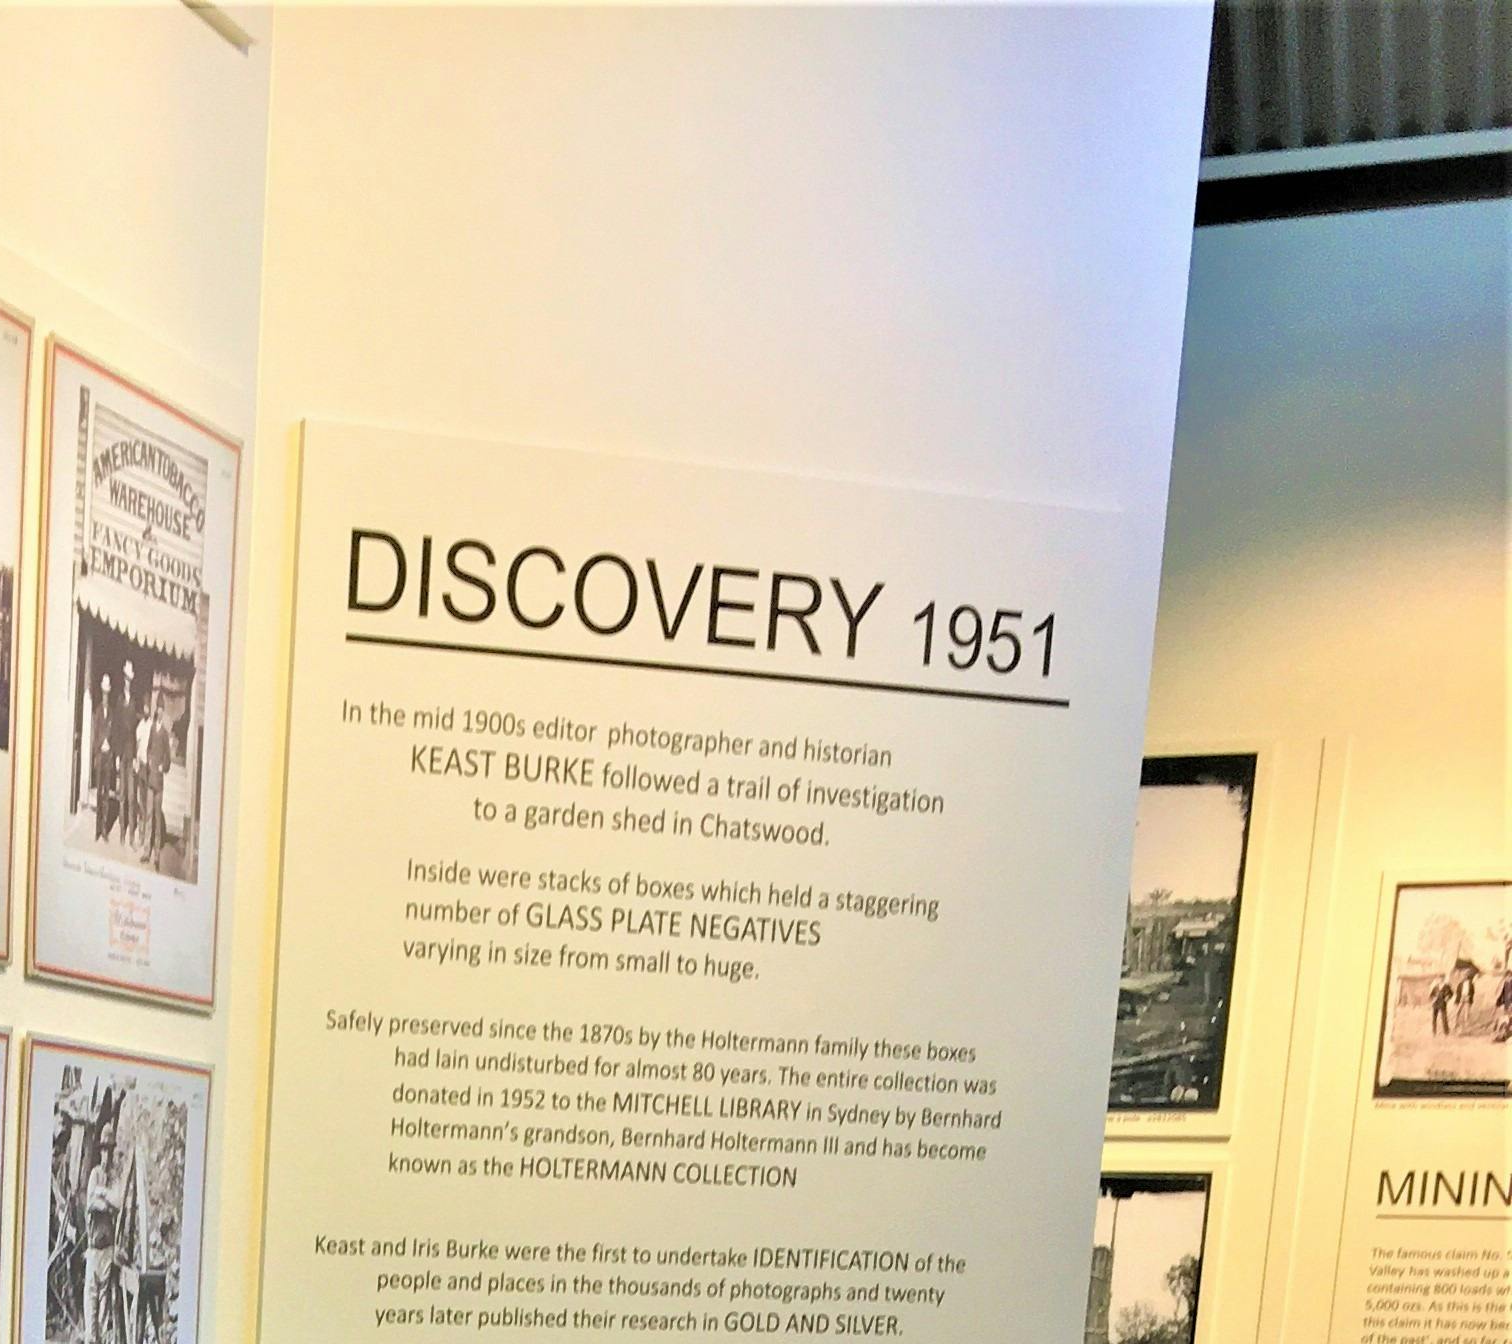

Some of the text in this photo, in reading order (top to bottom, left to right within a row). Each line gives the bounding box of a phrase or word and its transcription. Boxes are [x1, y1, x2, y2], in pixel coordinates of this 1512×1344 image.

[109, 475, 191, 541] WAREHOUSE
[90, 546, 198, 618] EMPORIUM
[92, 520, 201, 588] FANCY GOODS
[348, 528, 1058, 678] DISCOVERY 1951
[343, 700, 891, 766] In the mid 1900s editor photographer and historian
[412, 745, 943, 815] KEAST BURKE followed a trail of investigation
[474, 798, 828, 845] to a garden shed in Chatswood.
[408, 859, 939, 921] Inside were stacks of boxes which held a staggering
[406, 900, 820, 945] number of GLASS PLATE NEGATIVES
[404, 939, 758, 983] varying in size from small to huge.
[393, 1083, 1002, 1129] donated in 1952 to the MITCHELL LIBRARY in Sydney by Bernhard
[1369, 1265, 1405, 1278] Valley
[1409, 1265, 1429, 1277] has
[1433, 1266, 1480, 1278] washed
[1484, 1269, 1499, 1279] up
[1372, 1247, 1393, 1260] The
[1397, 1247, 1441, 1260] famous
[1445, 1248, 1478, 1261] claim
